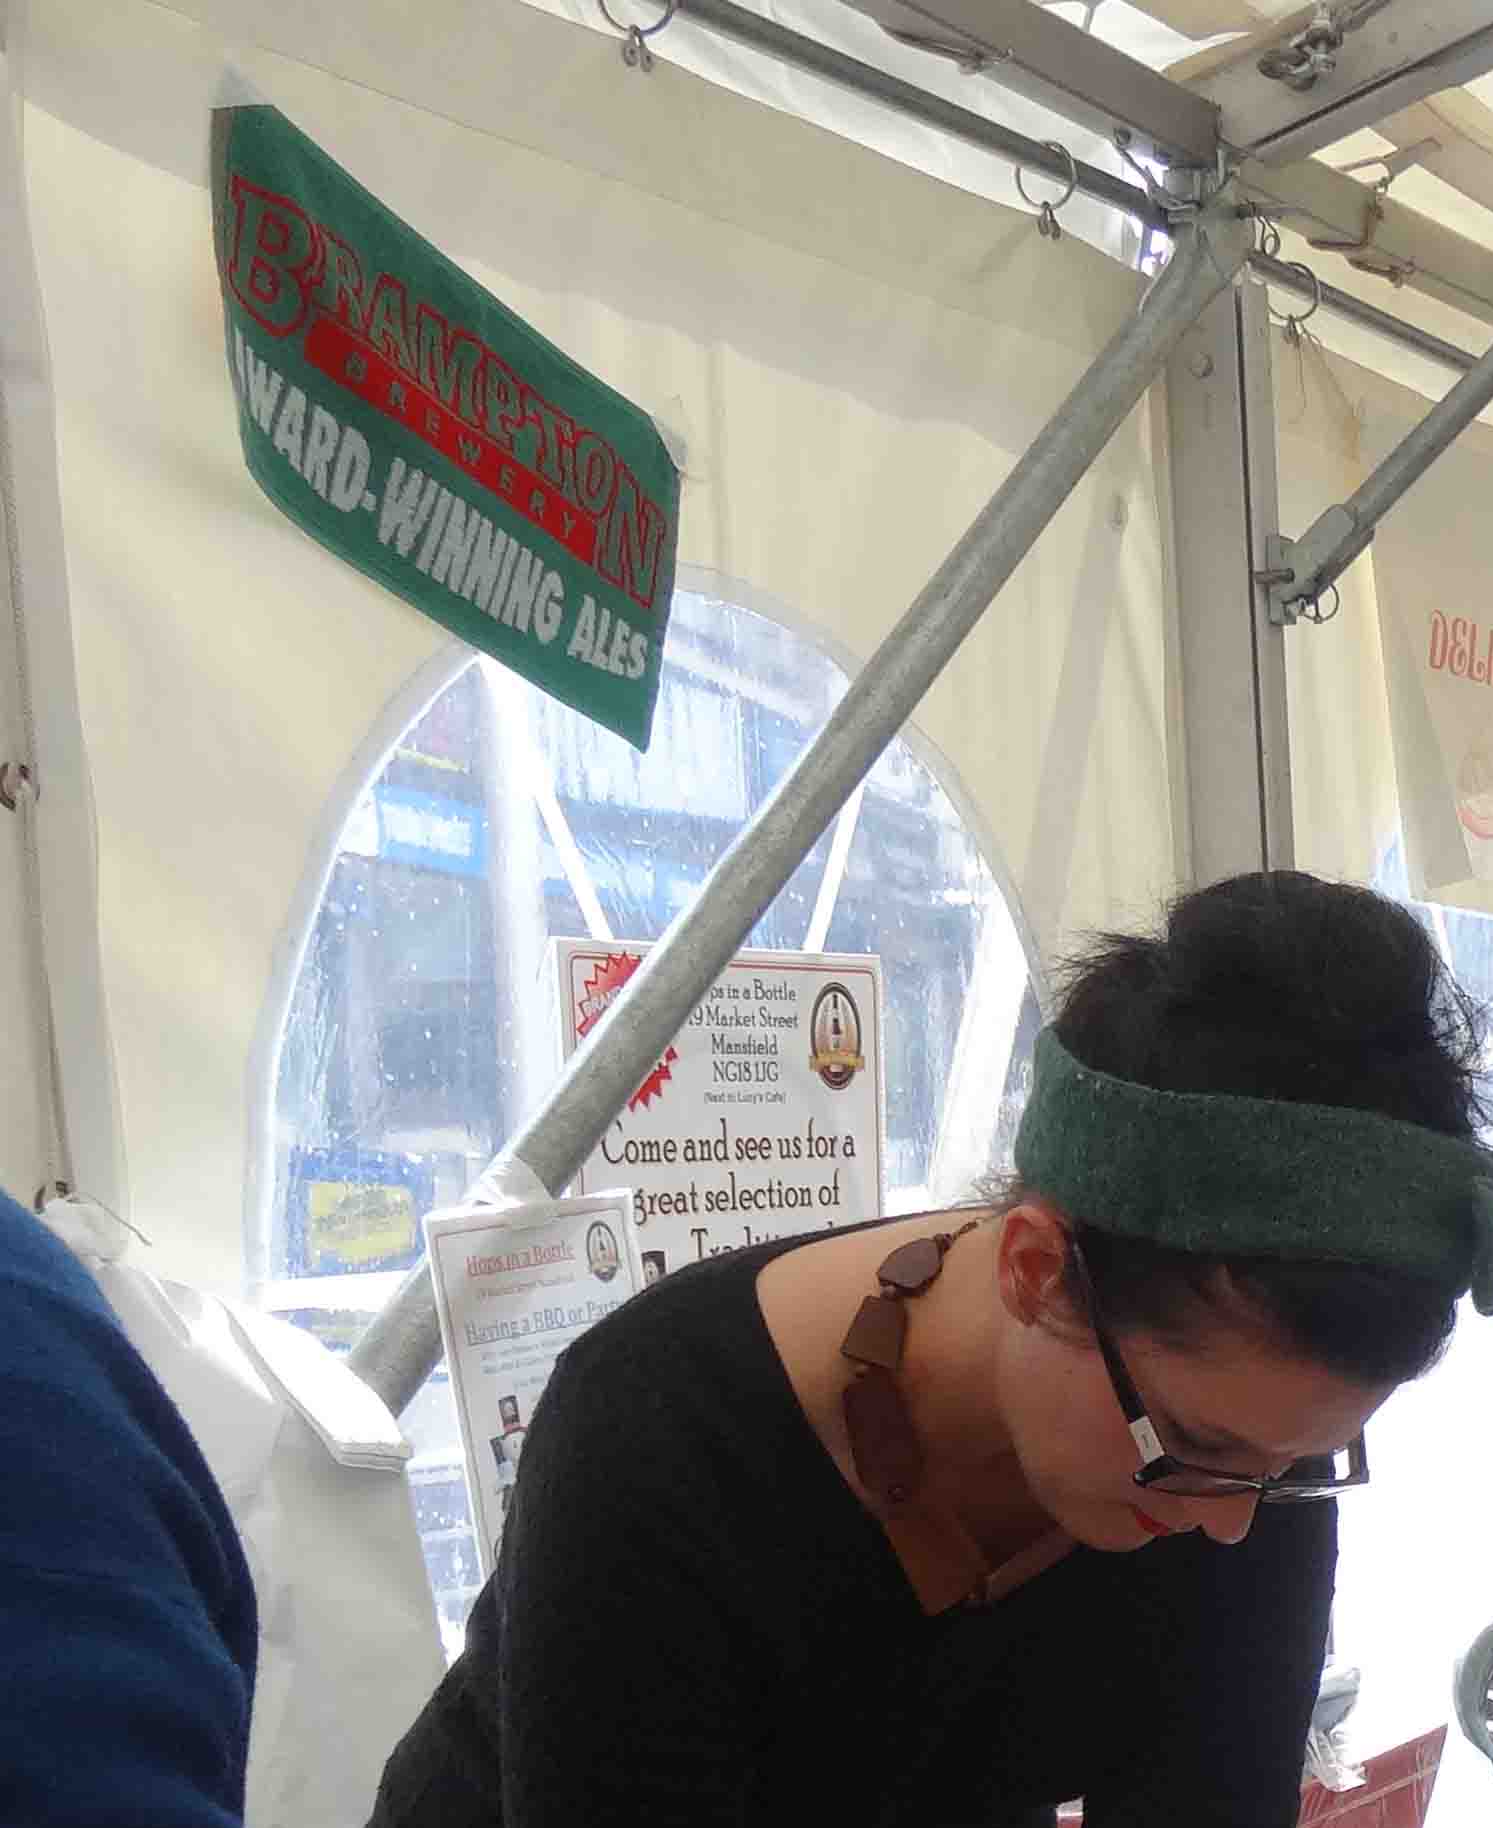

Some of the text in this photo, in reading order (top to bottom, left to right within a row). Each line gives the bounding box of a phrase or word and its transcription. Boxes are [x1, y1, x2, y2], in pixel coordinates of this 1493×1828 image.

[226, 173, 666, 610] BRAMPTON
[343, 355, 580, 542] BREWERY
[569, 592, 648, 680] ALES
[729, 982, 740, 999] in
[743, 986, 752, 999] a
[753, 979, 797, 1002] Bottle
[705, 1007, 758, 1029] Market
[759, 1006, 800, 1030] Street
[711, 1033, 779, 1056] Mansfield
[713, 1060, 752, 1083] NG18
[601, 1117, 857, 1165] Come and see us for a
[633, 1167, 842, 1228] great selection of
[532, 1306, 567, 1331] BBQ
